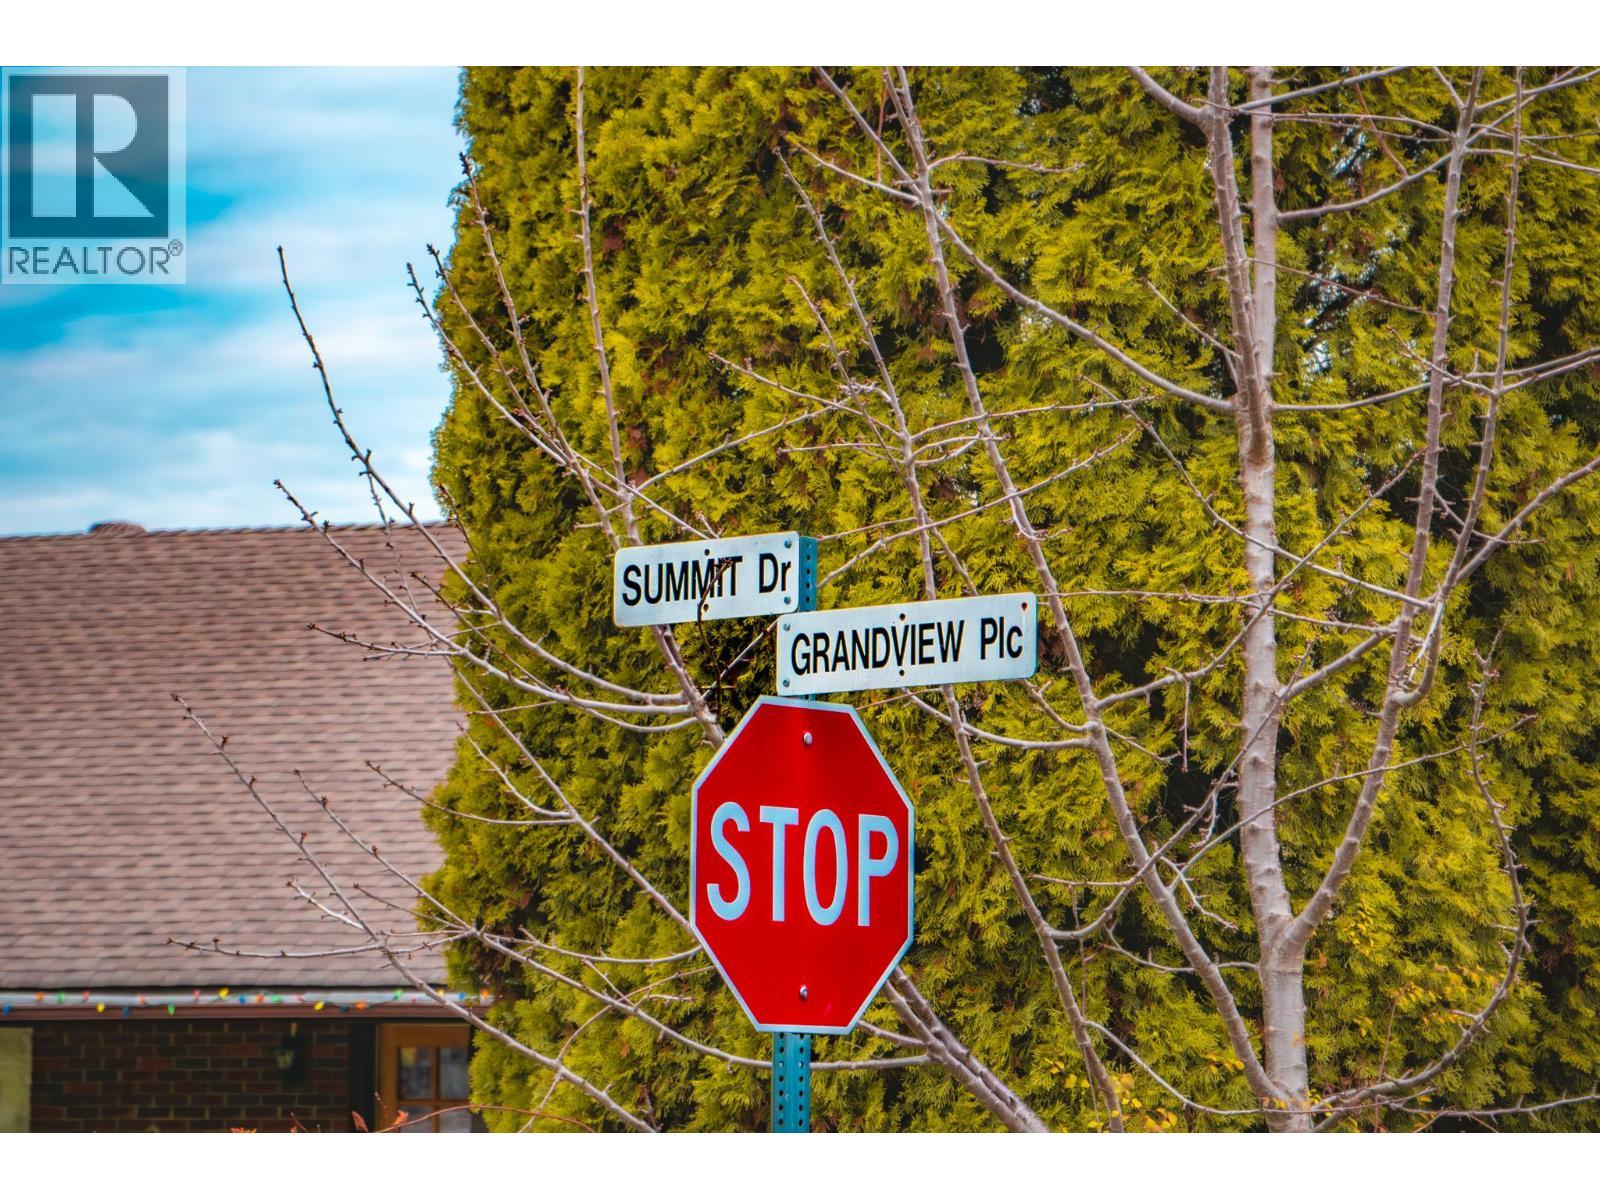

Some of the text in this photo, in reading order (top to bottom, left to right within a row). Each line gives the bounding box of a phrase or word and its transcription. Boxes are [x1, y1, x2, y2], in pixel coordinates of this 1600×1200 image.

[622, 552, 792, 606] SUMMIT Dr
[791, 616, 1023, 676] GRANDVIEW Plc
[707, 801, 899, 927] STOP
